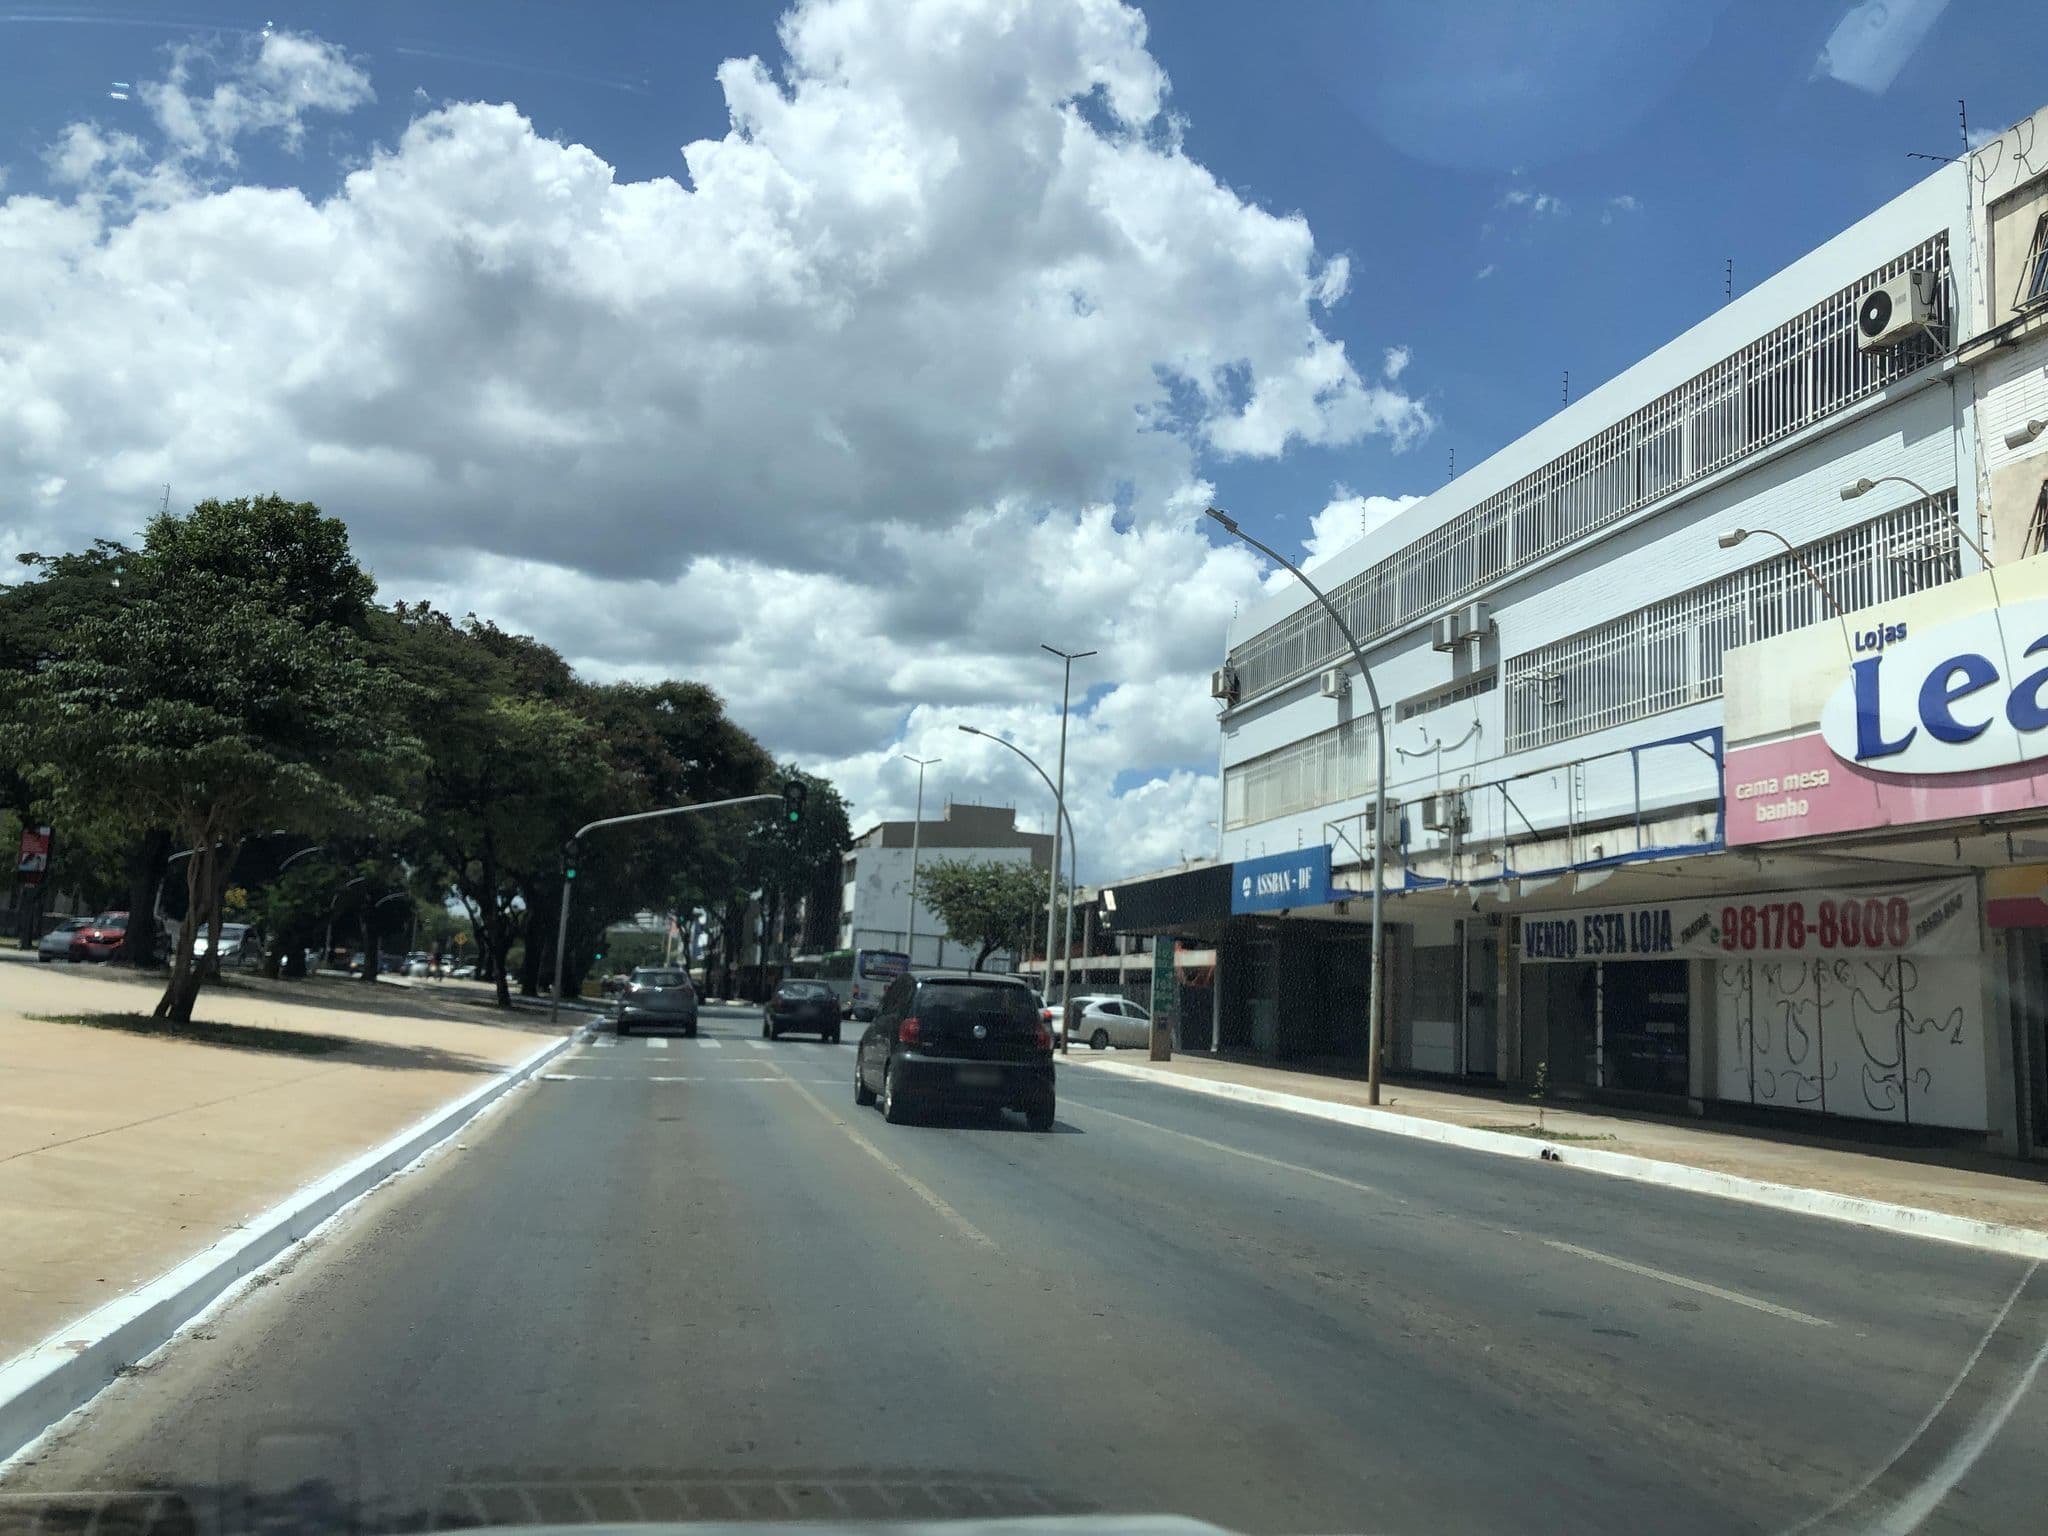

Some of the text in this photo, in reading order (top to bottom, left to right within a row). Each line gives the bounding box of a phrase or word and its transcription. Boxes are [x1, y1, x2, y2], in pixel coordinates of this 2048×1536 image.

[1855, 622, 1907, 651] Lojas
[1736, 768, 1830, 800] cama mesa
[1756, 799, 1809, 823] banho
[1299, 866, 1312, 890] DF
[1526, 919, 1578, 958] VENDO
[1583, 913, 1626, 954] ESTA
[1630, 909, 1673, 953] LOJA
[1721, 897, 1910, 950] 98178-8000
